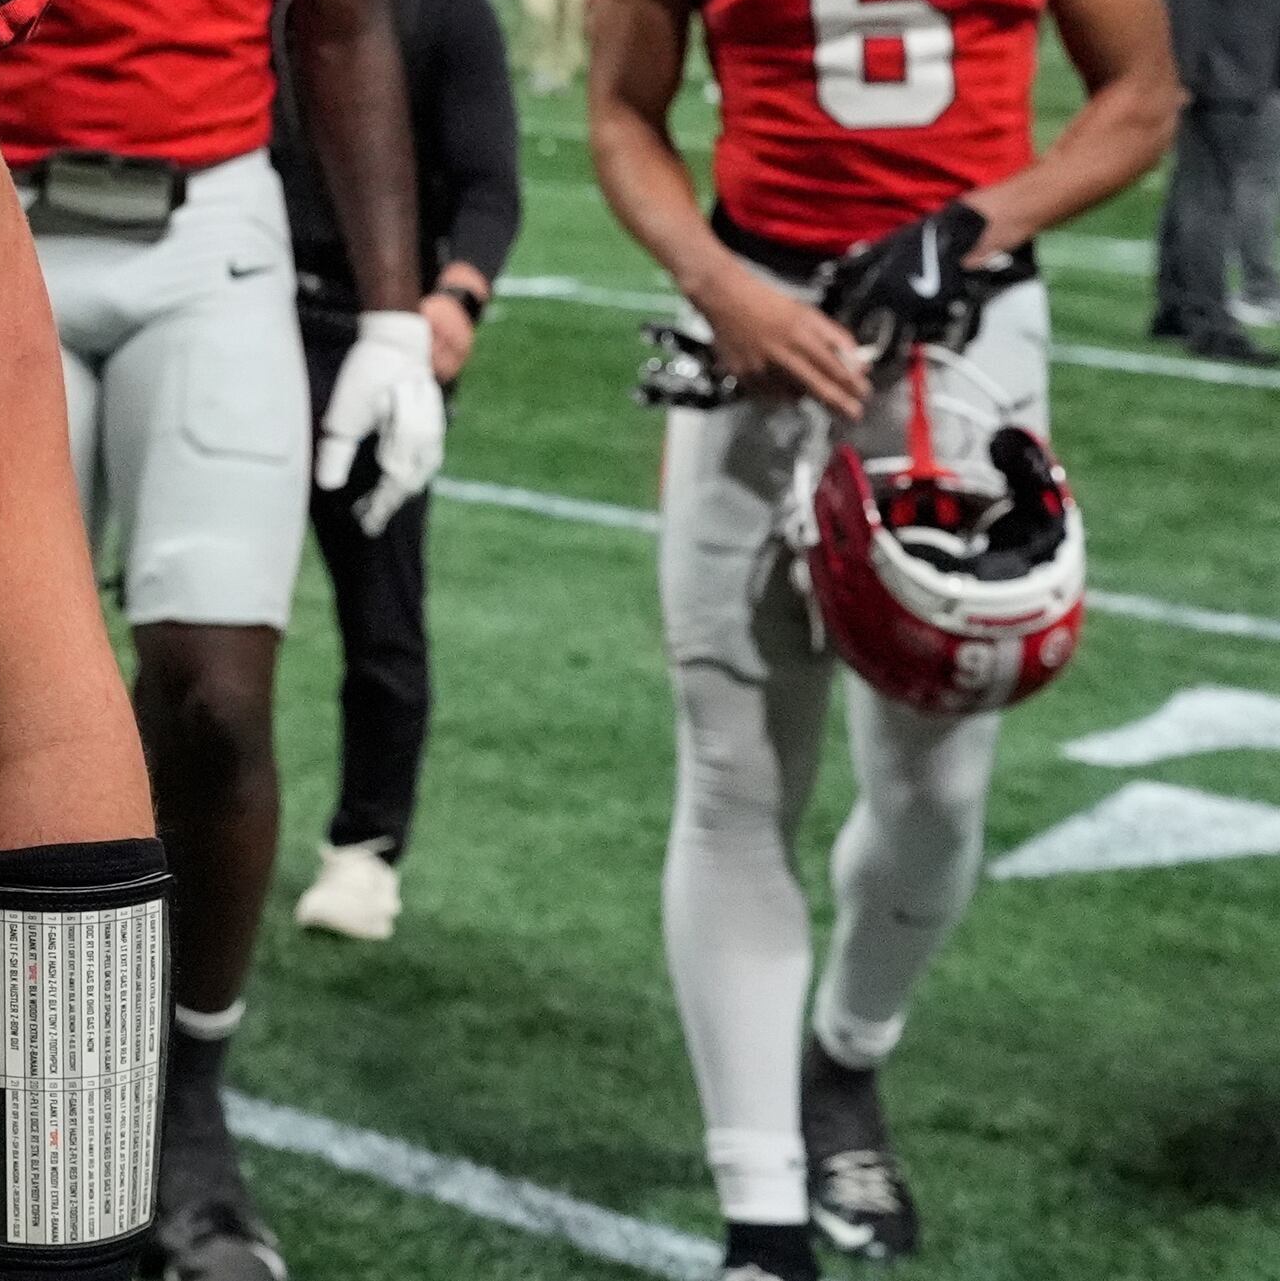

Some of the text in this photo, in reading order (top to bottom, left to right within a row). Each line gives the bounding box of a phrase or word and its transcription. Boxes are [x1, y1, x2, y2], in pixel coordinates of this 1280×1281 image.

[9, 924, 18, 941] GANG
[86, 926, 94, 939] DOC
[120, 922, 128, 943] TRUMP
[28, 932, 36, 951] FLANK
[86, 951, 95, 962] OFF
[120, 954, 128, 967] EXIT
[10, 970, 18, 981] BLK
[48, 961, 57, 978] HASH
[86, 964, 95, 983] F-GAS
[29, 985, 37, 996] BLK
[48, 980, 57, 997] Z-FLY
[86, 985, 95, 996] BLK
[120, 991, 128, 1002] BLK
[10, 984, 18, 1013] HUSTLER
[49, 1000, 57, 1010] BLK
[29, 1000, 37, 1022] WOODY
[10, 1015, 19, 1036] Z-BOW
[49, 1014, 57, 1030] TONY
[87, 1017, 95, 1030] GAS
[120, 1005, 128, 1046] WASHINGTON
[29, 1024, 37, 1043] EXTRA
[87, 1032, 95, 1052] F-NOW
[10, 1038, 19, 1050] OUT
[29, 1045, 38, 1076] Z-BANANA
[49, 1032, 58, 1074] Z-TOOTHPICK
[30, 1092, 39, 1109] Z-FLY
[49, 1099, 57, 1118] FLANK
[69, 1128, 77, 1145] HASH
[30, 1145, 40, 1157] STK
[50, 1152, 58, 1164] RED
[69, 1148, 77, 1164] Z-FLY
[31, 1159, 40, 1171] BLK
[69, 1167, 78, 1179] RED
[50, 1166, 58, 1188] WOODY
[31, 1173, 40, 1202] PLAYBOY
[70, 1182, 78, 1197] TONY
[50, 1191, 58, 1209] EXTRA
[51, 1212, 59, 1242] Z-BANANA
[70, 1200, 78, 1241] Z-TOOTHPICK
